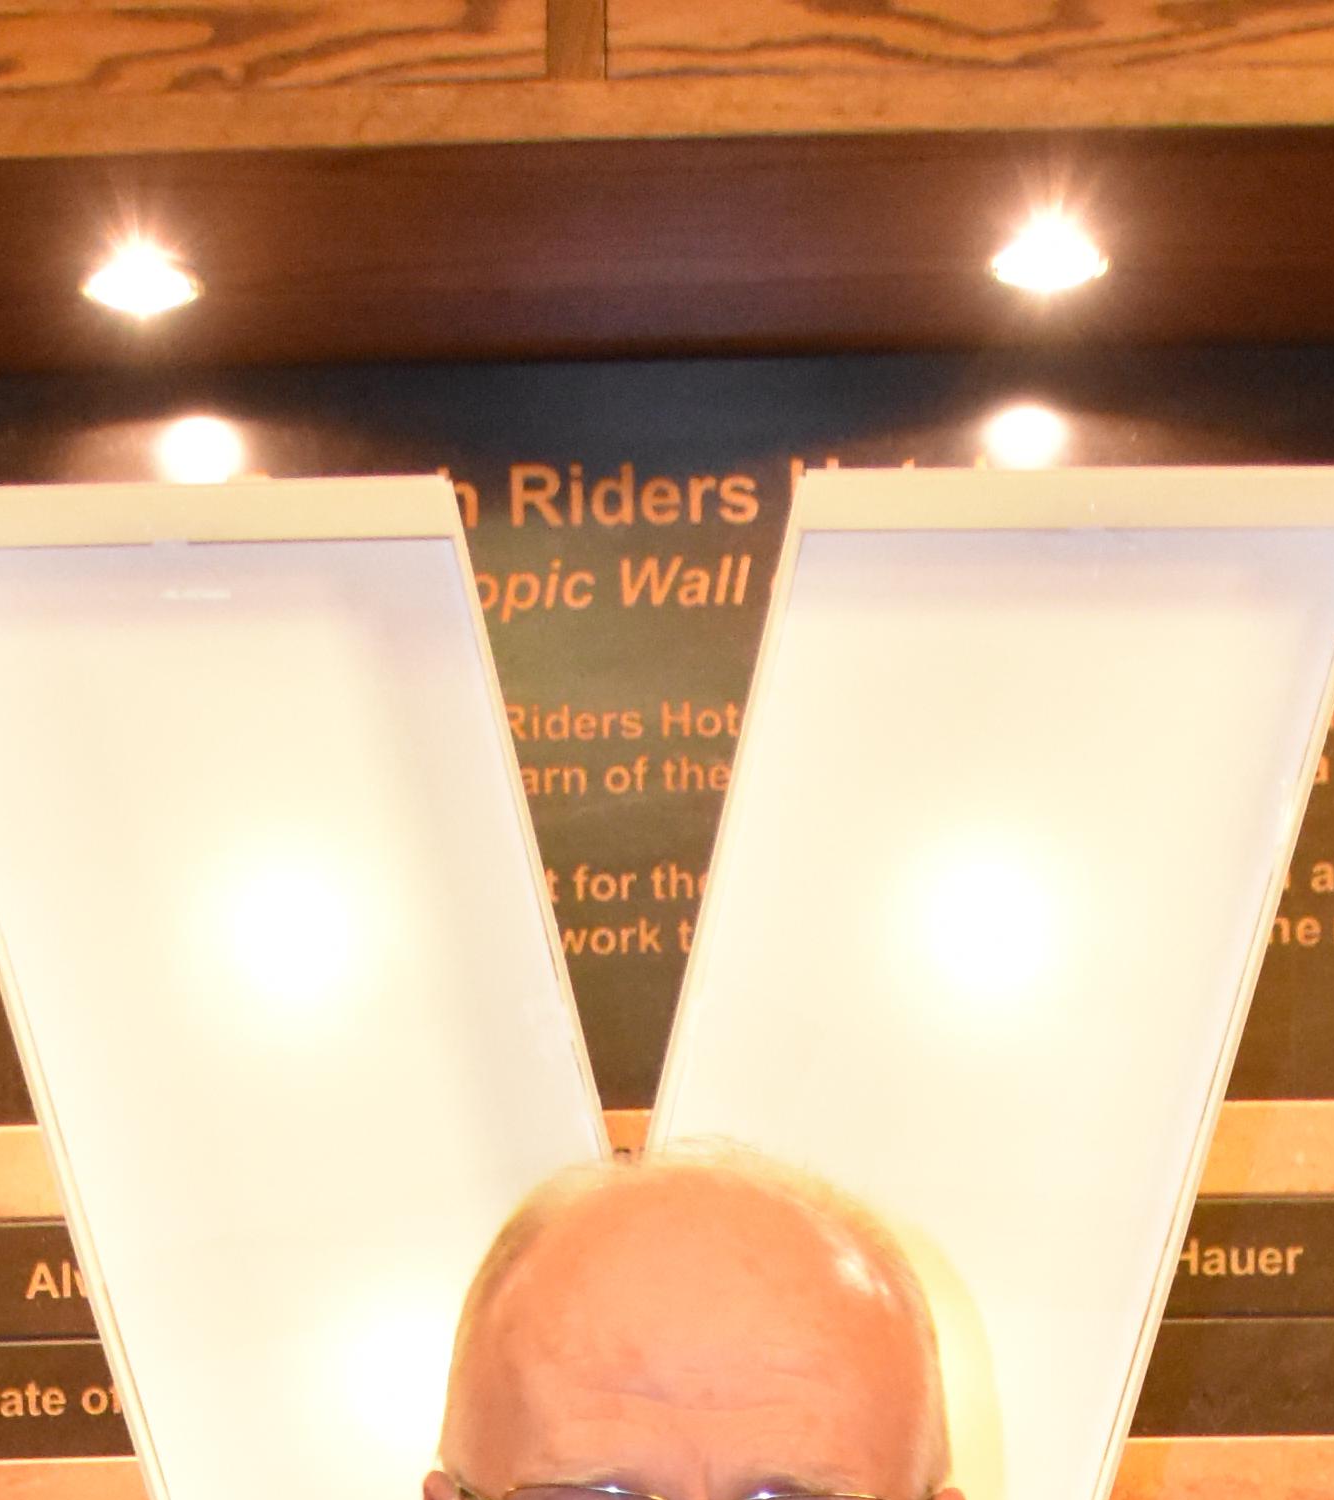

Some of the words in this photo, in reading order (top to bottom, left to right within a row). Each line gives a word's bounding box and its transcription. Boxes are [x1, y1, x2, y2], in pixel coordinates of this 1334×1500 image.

[509, 462, 760, 528] Riders
[620, 553, 752, 608] Wall
[503, 703, 644, 741] Riders
[660, 701, 741, 738] Hot
[521, 766, 588, 797] arn
[603, 755, 649, 794] of
[663, 754, 730, 793] the
[572, 864, 637, 902] for
[563, 916, 662, 955] work
[1268, 914, 1322, 947] he
